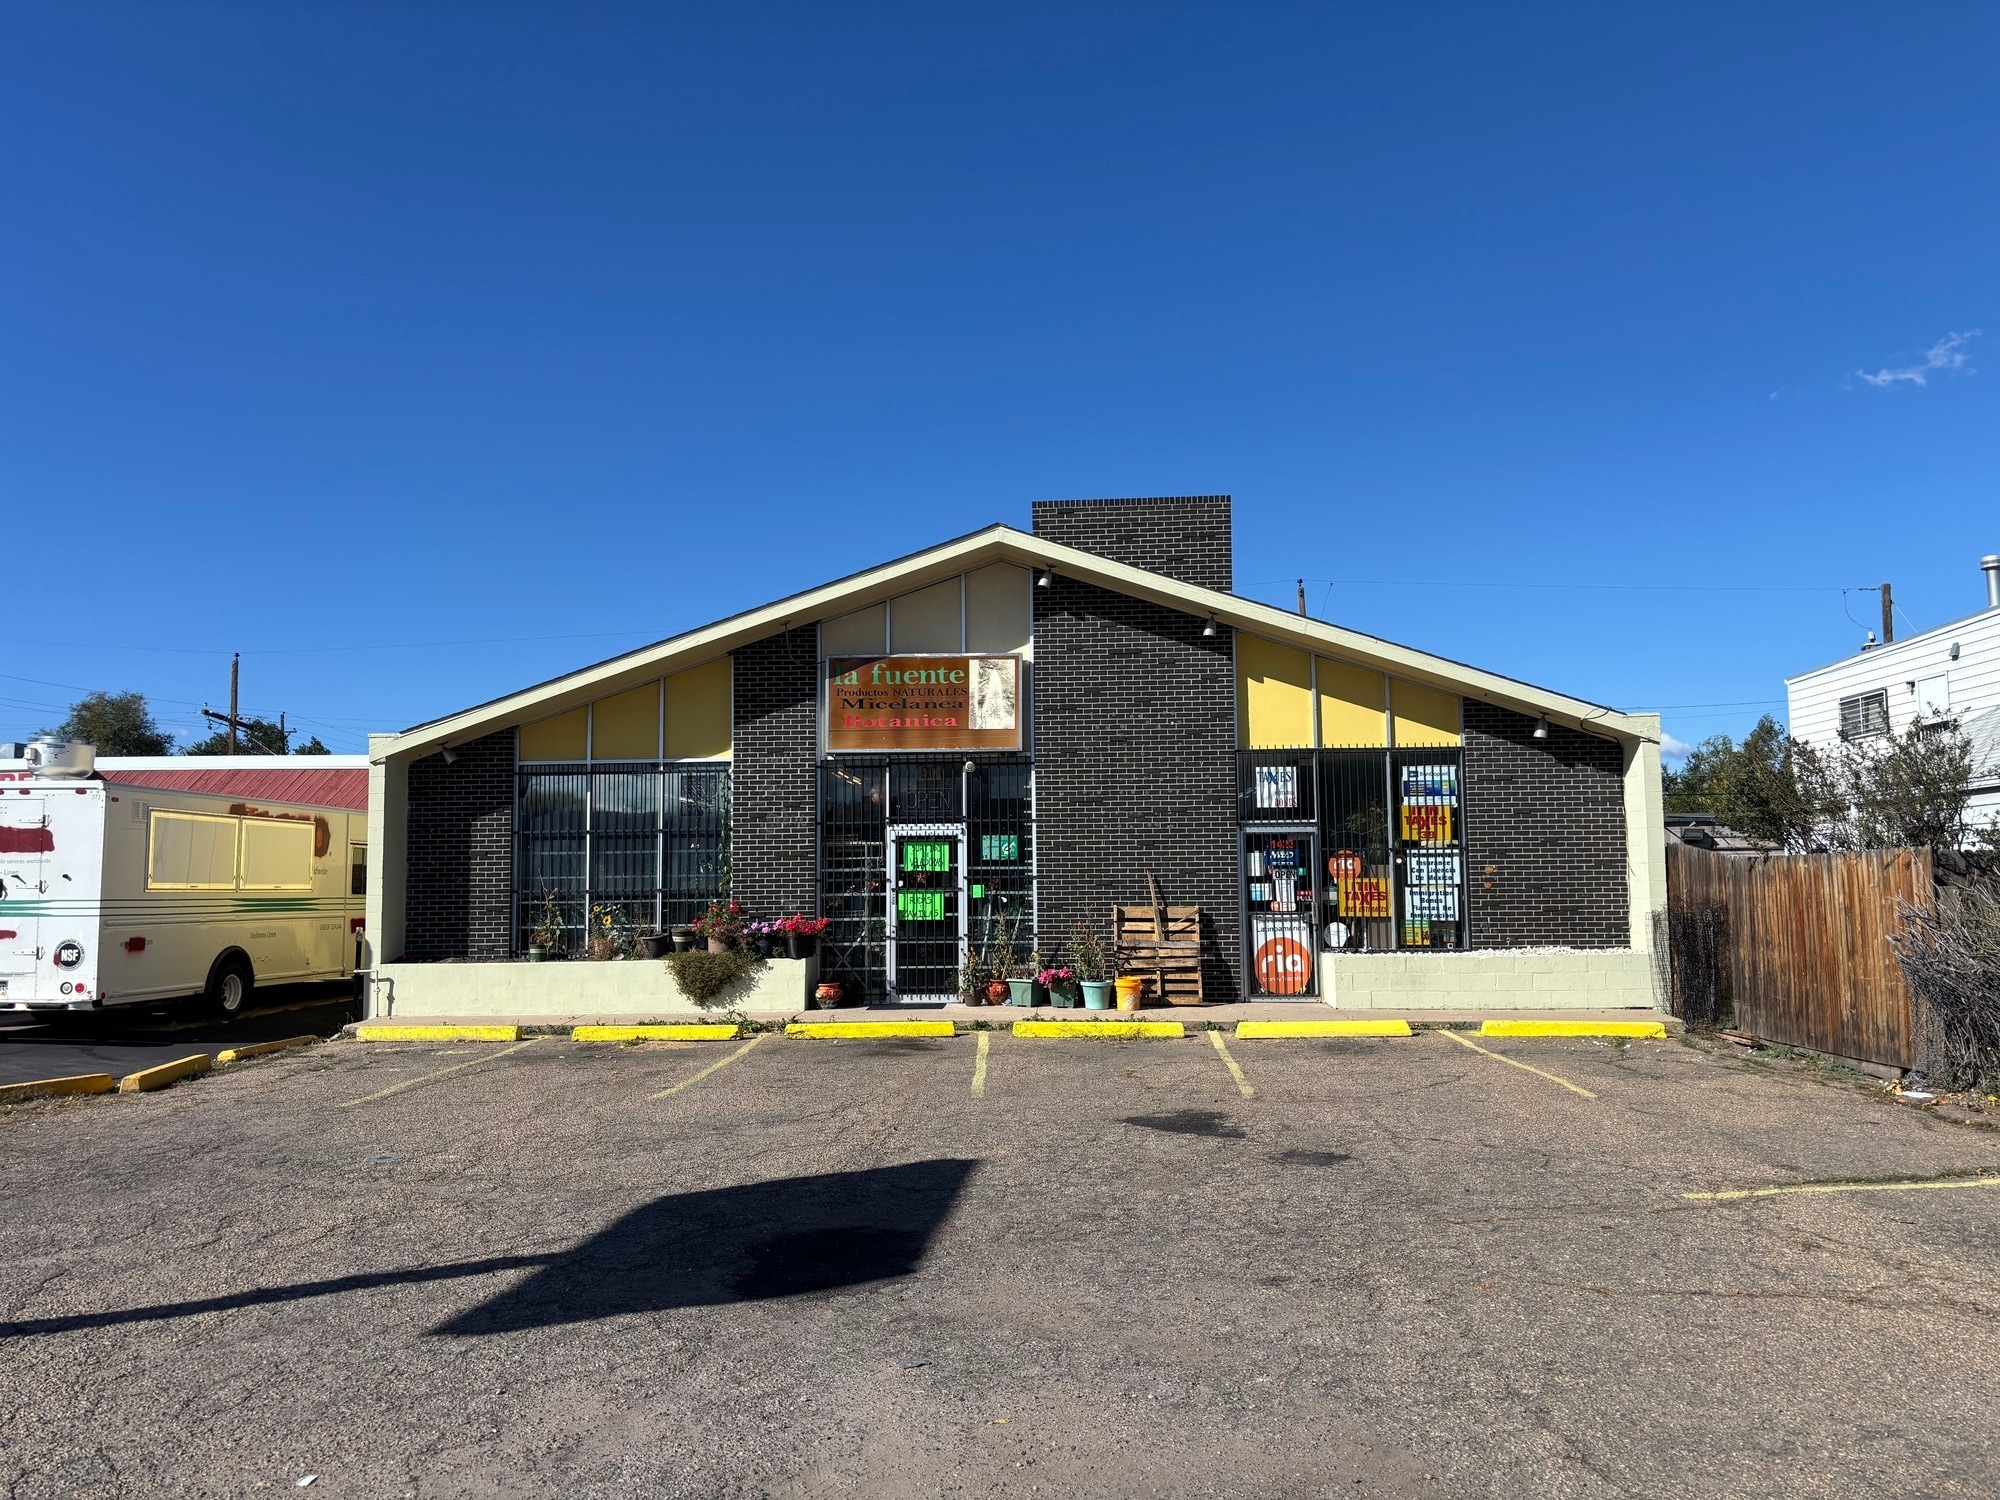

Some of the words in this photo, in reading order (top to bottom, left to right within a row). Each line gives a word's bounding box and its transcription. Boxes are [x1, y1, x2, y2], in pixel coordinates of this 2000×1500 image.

[833, 664, 859, 685] la
[871, 663, 965, 685] fuente
[836, 688, 889, 697] Productos
[893, 687, 968, 697] NATURALES
[840, 698, 963, 710] Micelanea
[843, 714, 958, 728] Botanica
[1257, 771, 1292, 785] TAXES
[907, 791, 950, 809] OPEN
[1404, 816, 1448, 830] TAXES
[1275, 871, 1296, 879] OPEN
[1344, 891, 1387, 905] TAXES
[61, 949, 79, 961] NSF
[1262, 945, 1305, 974] ria
